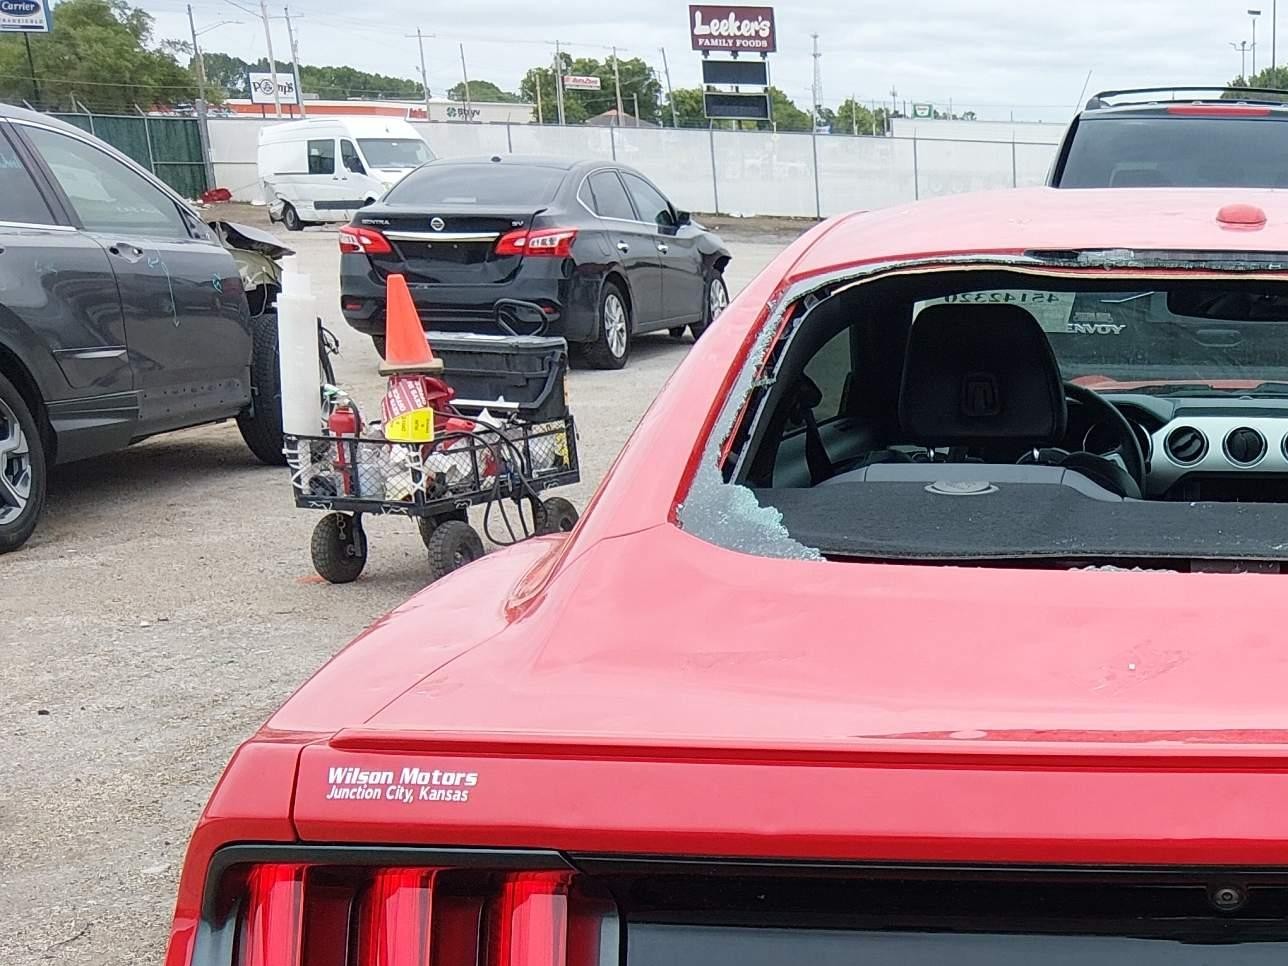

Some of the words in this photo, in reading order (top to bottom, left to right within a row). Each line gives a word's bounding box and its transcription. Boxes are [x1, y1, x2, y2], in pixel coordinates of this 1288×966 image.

[1, 1, 36, 11] Carrier
[693, 10, 771, 38] Leeker's
[698, 38, 733, 47] FAMILY
[736, 39, 768, 48] FOODS
[1067, 323, 1127, 335] ENVOY
[327, 767, 394, 785] Wilson
[399, 767, 478, 786] Motors
[326, 783, 381, 800] Junction
[385, 785, 414, 803] City,
[418, 786, 469, 801] Kansas
